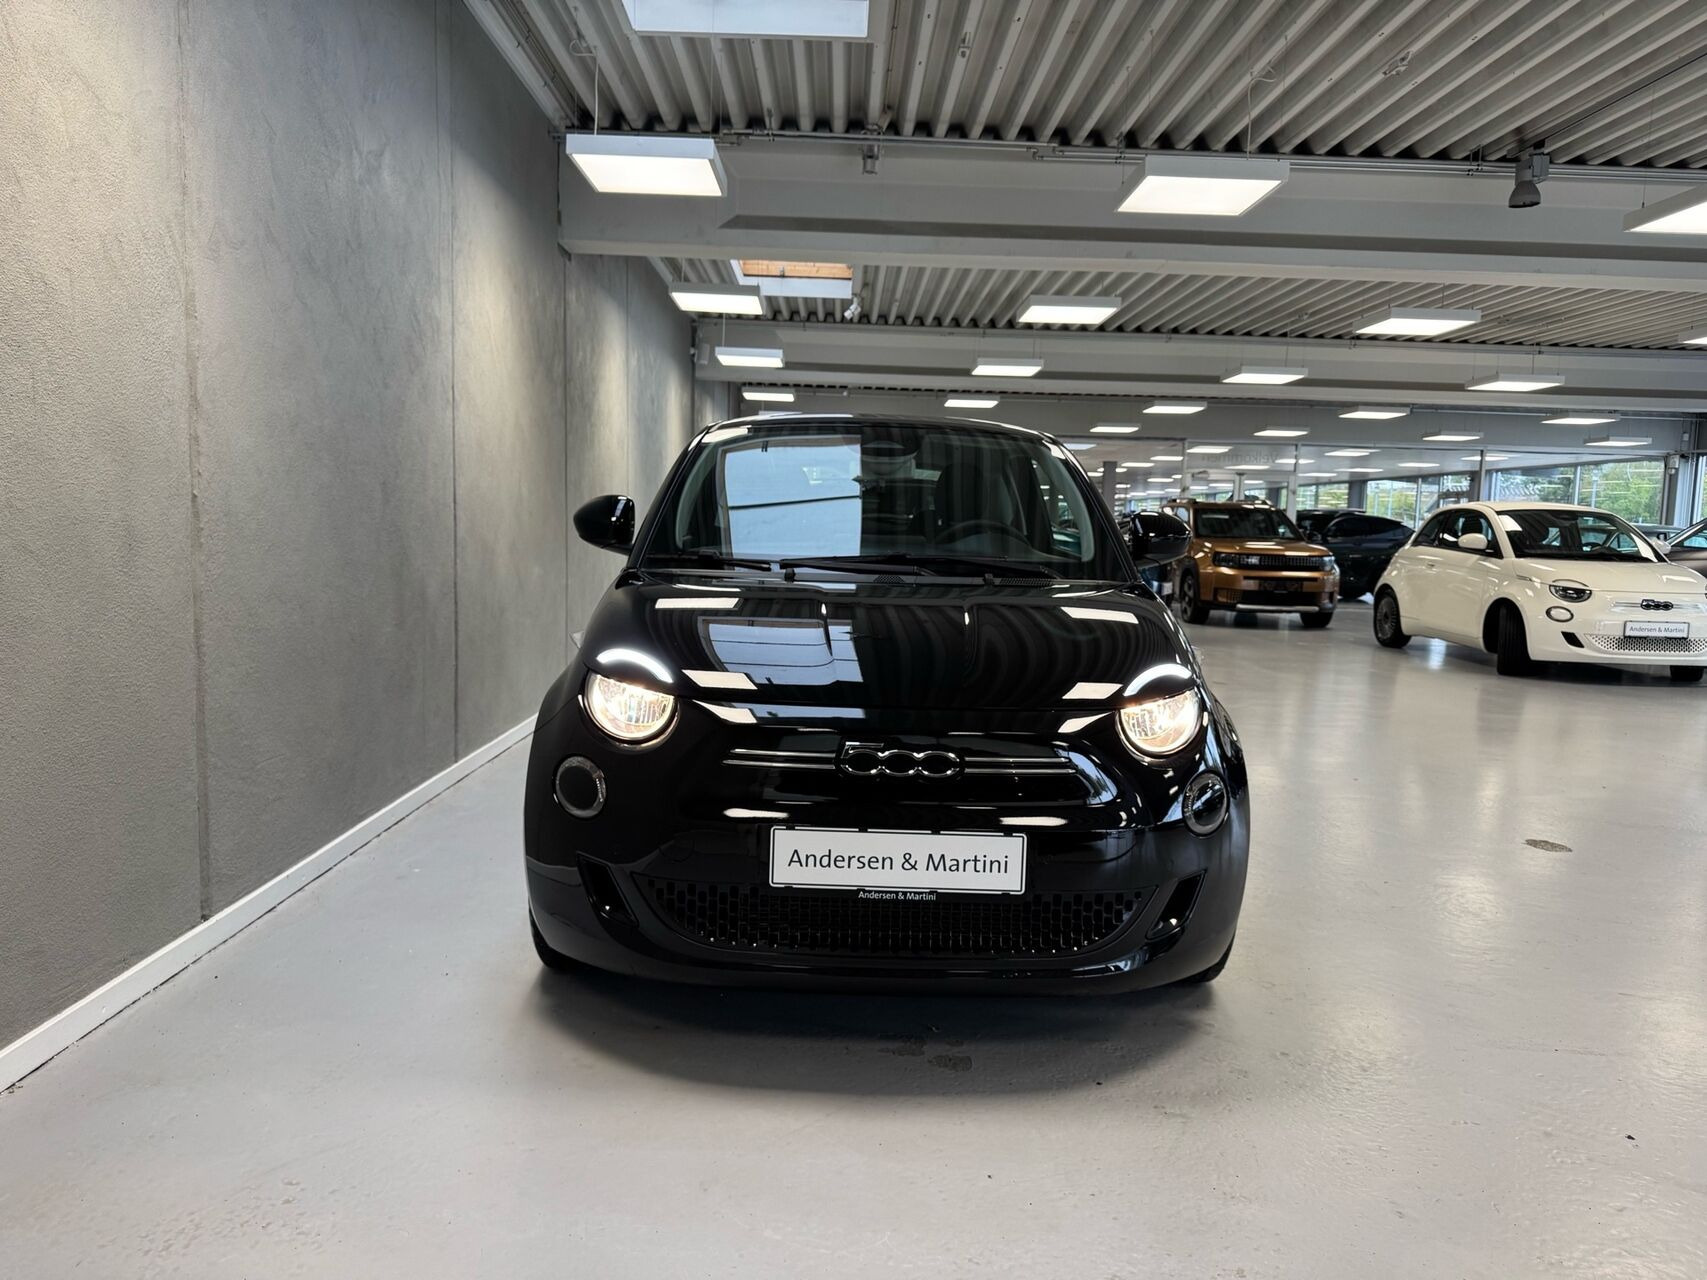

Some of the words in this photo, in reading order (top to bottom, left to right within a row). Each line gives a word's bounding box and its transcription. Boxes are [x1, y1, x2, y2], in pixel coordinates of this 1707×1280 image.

[1629, 625, 1657, 633] Andersen
[840, 741, 960, 778] 500
[787, 848, 894, 871] Andersen
[900, 852, 918, 871] &
[925, 853, 1009, 874] Martini
[858, 890, 896, 900] Andersen
[897, 891, 905, 900] &
[906, 892, 937, 901] Martini
